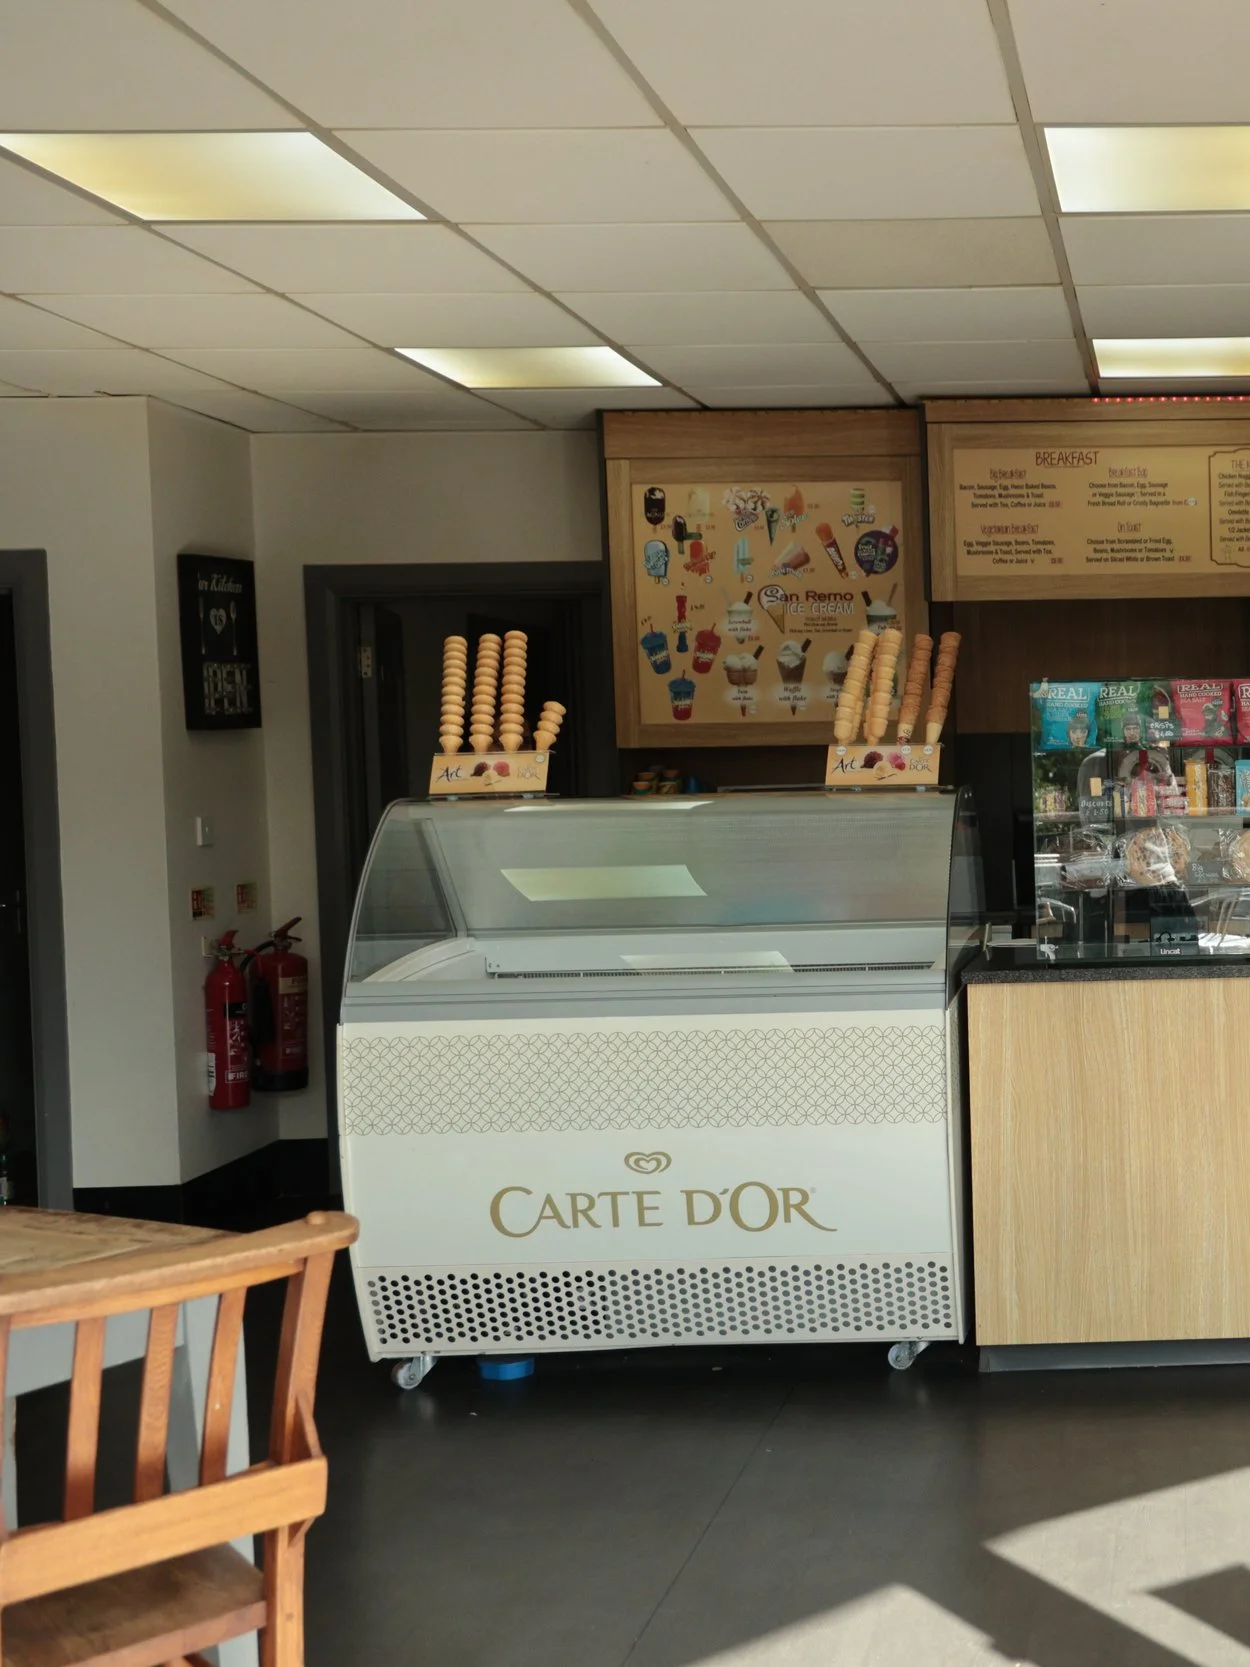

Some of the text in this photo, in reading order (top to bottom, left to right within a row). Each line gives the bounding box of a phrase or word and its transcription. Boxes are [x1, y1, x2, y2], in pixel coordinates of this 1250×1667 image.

[1036, 450, 1100, 466] BREAKFAST
[1231, 459, 1246, 470] THE
[764, 587, 855, 604] San Remo
[786, 602, 856, 615] ICE CREAM
[1048, 686, 1087, 701] REAL
[1099, 685, 1138, 699] REAL
[1180, 683, 1221, 693] REAL
[1180, 690, 1222, 699] HAND COOKED
[831, 756, 857, 774] Art
[435, 765, 462, 783] Art
[489, 1180, 839, 1239] CARTE D'OR
